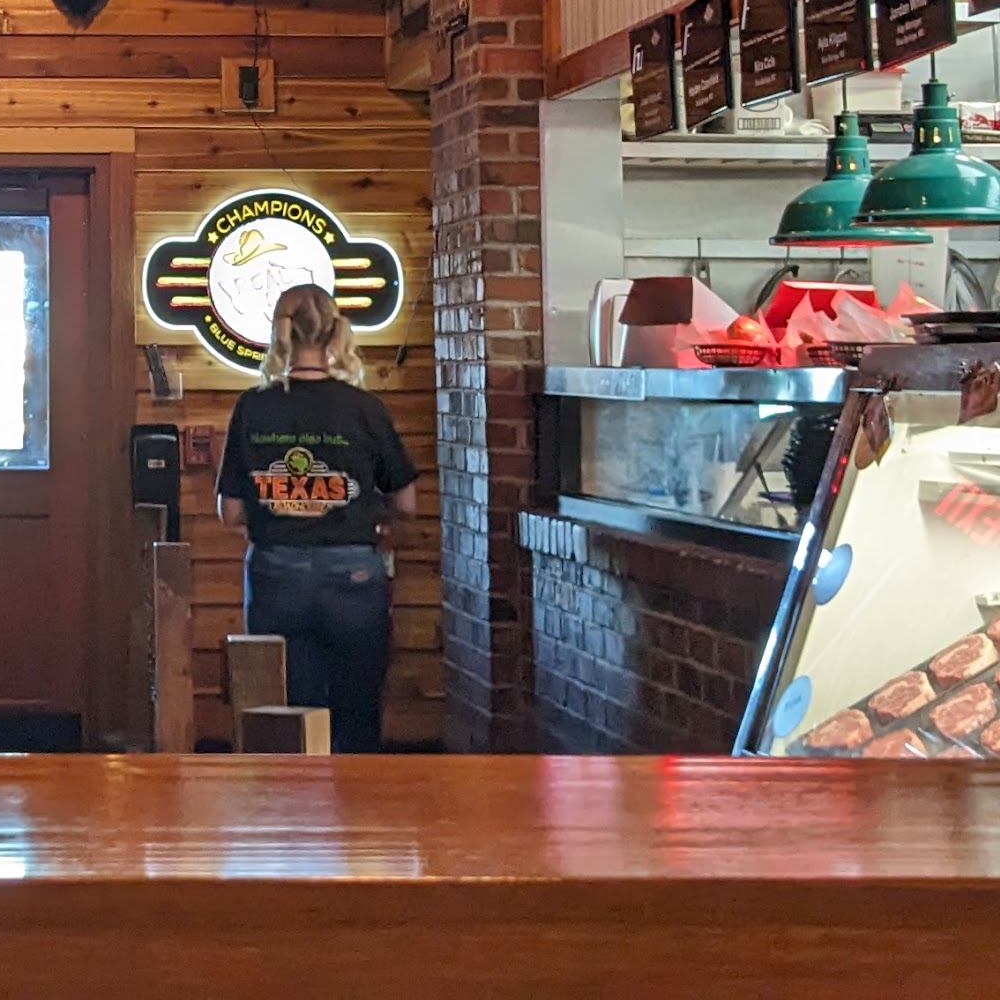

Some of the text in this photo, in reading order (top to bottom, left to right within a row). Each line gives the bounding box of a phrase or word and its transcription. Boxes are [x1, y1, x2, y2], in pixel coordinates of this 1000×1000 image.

[215, 200, 328, 234] CHAMPIONS
[209, 322, 268, 361] BLUE SPRI
[254, 476, 346, 500] TEXAS
